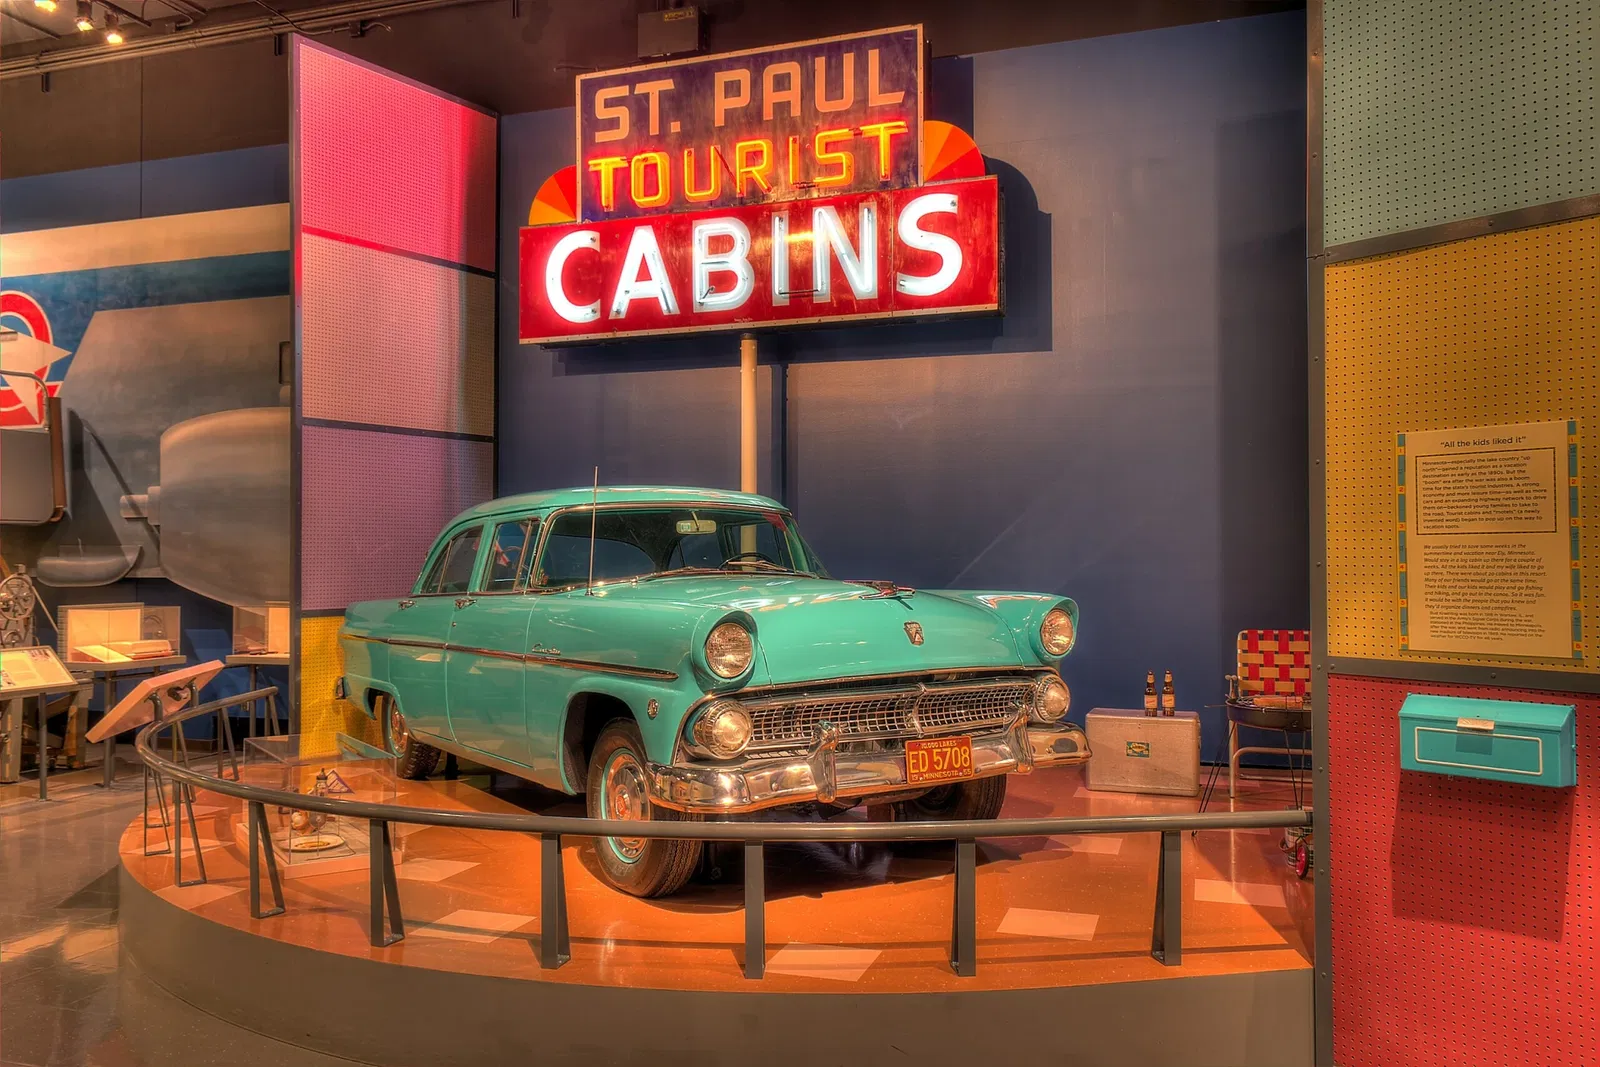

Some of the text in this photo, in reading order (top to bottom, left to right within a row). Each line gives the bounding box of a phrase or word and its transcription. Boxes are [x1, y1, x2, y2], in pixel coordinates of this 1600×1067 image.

[594, 48, 906, 143] ST. PAUL
[588, 120, 908, 212] TOURIST
[544, 193, 963, 324] CABINS
[909, 746, 970, 773] ED 5708
[923, 770, 959, 779] MINNESOTA
